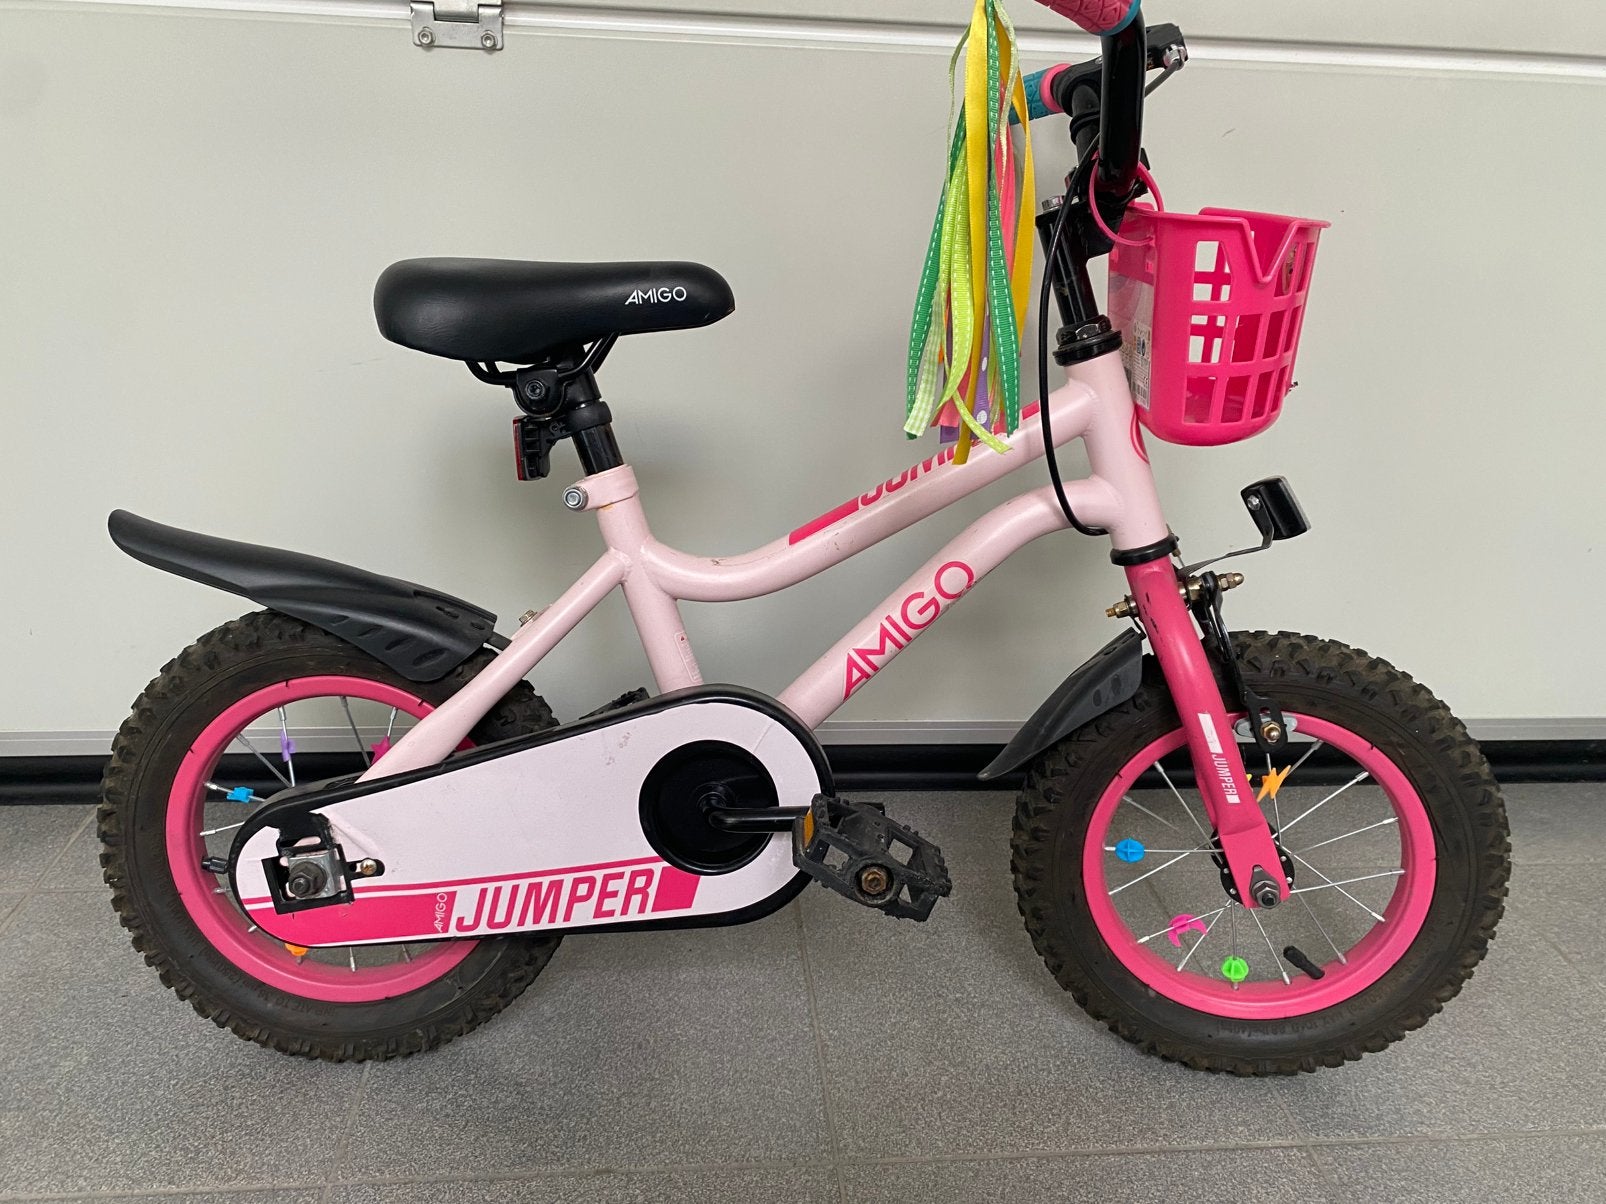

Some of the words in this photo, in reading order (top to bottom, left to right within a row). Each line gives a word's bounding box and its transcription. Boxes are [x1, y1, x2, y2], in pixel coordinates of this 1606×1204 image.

[624, 286, 687, 305] AMIGO
[843, 561, 975, 702] AMIGO
[1212, 754, 1238, 795] JUMPER
[434, 892, 448, 933] AMIGO
[455, 868, 655, 933] JUMPER
